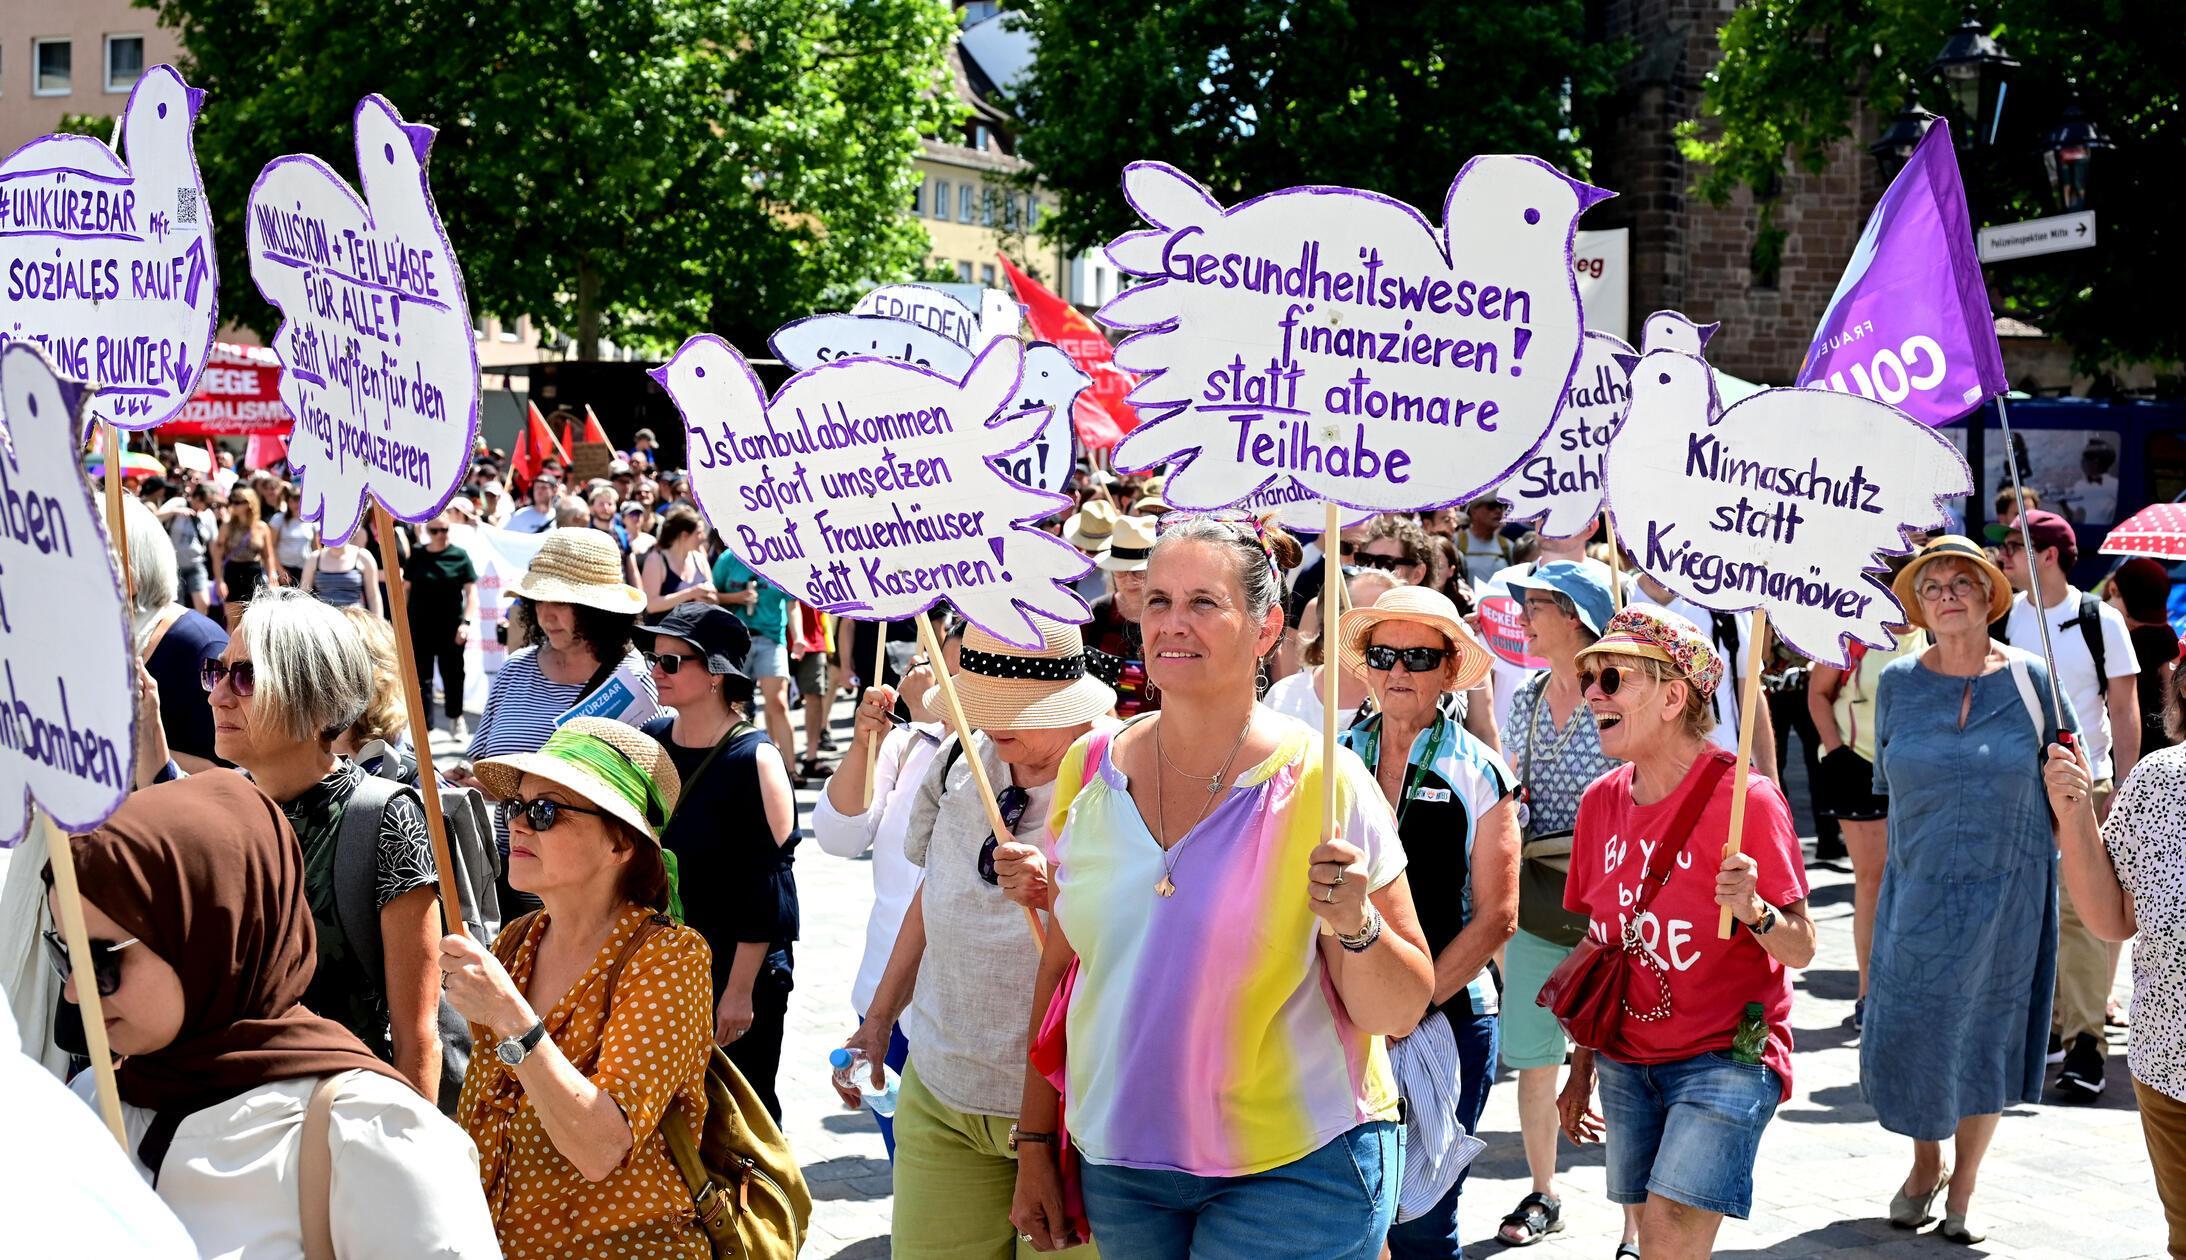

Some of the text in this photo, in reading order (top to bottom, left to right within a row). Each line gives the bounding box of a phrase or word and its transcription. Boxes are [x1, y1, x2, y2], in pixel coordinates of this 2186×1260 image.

[8, 247, 185, 301] SOZIALES RAUF
[254, 200, 439, 297] INKLUSION + TEILHABE
[1162, 225, 1532, 324] Gesundheitswesen
[1576, 257, 1604, 279] eg
[303, 266, 340, 323] FÜR
[96, 335, 175, 386] RUNTER
[291, 317, 446, 431] statt Waffen für den
[1202, 354, 1500, 433] statt atomare
[297, 382, 432, 490] Krieg produzieren
[689, 400, 953, 469] Istanbulabkommen
[1228, 413, 1412, 484] Teilhabe
[739, 463, 813, 514] sofort
[819, 447, 953, 499] umsetzen
[1685, 432, 1887, 515] Klimaschutz
[737, 502, 985, 566] Baut Frauenhäuser
[1709, 497, 1804, 545] statt
[806, 563, 859, 607] statt
[1645, 520, 1873, 620] Kriegsmanöver
[1604, 834, 1627, 875] Be
